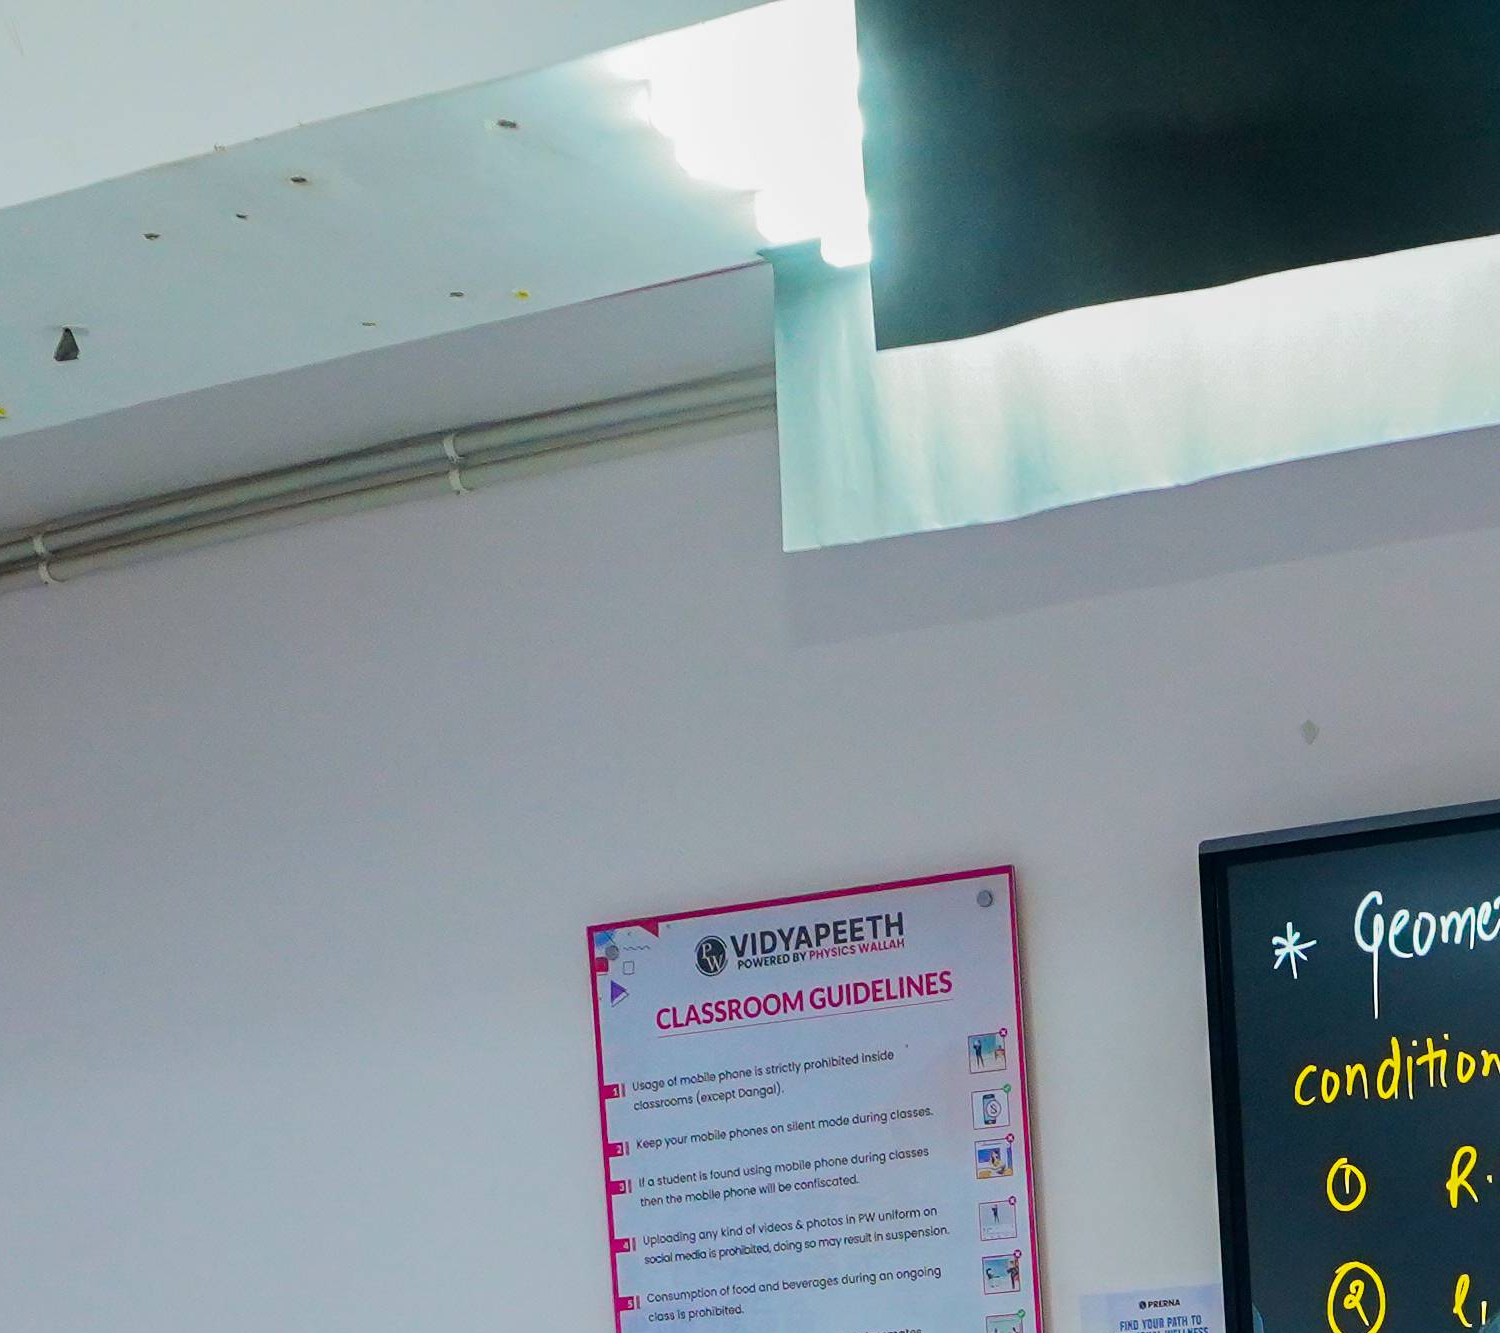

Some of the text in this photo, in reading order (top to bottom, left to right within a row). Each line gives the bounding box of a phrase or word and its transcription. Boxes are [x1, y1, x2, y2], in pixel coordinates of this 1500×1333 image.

[730, 911, 903, 958] VIDYAPEETH
[737, 938, 904, 970] POWERED BY PHYSICS WALLAH
[656, 970, 952, 1029] CLASSROOM GUIDELINES
[632, 1049, 894, 1092] Usage of mobile phone is strictly prohibited inside
[633, 1081, 784, 1111] classrooms (except Dangal).
[636, 1107, 933, 1149] Keep your mobile phones on silent mode during classes.
[638, 1147, 929, 1187] If a student is found using mobile phone during classes
[640, 1173, 859, 1207] then the mobile phone will be confiscated.
[1147, 1299, 1181, 1308] PRERNA
[1120, 1315, 1202, 1331] FIND YOUR PATH TO
